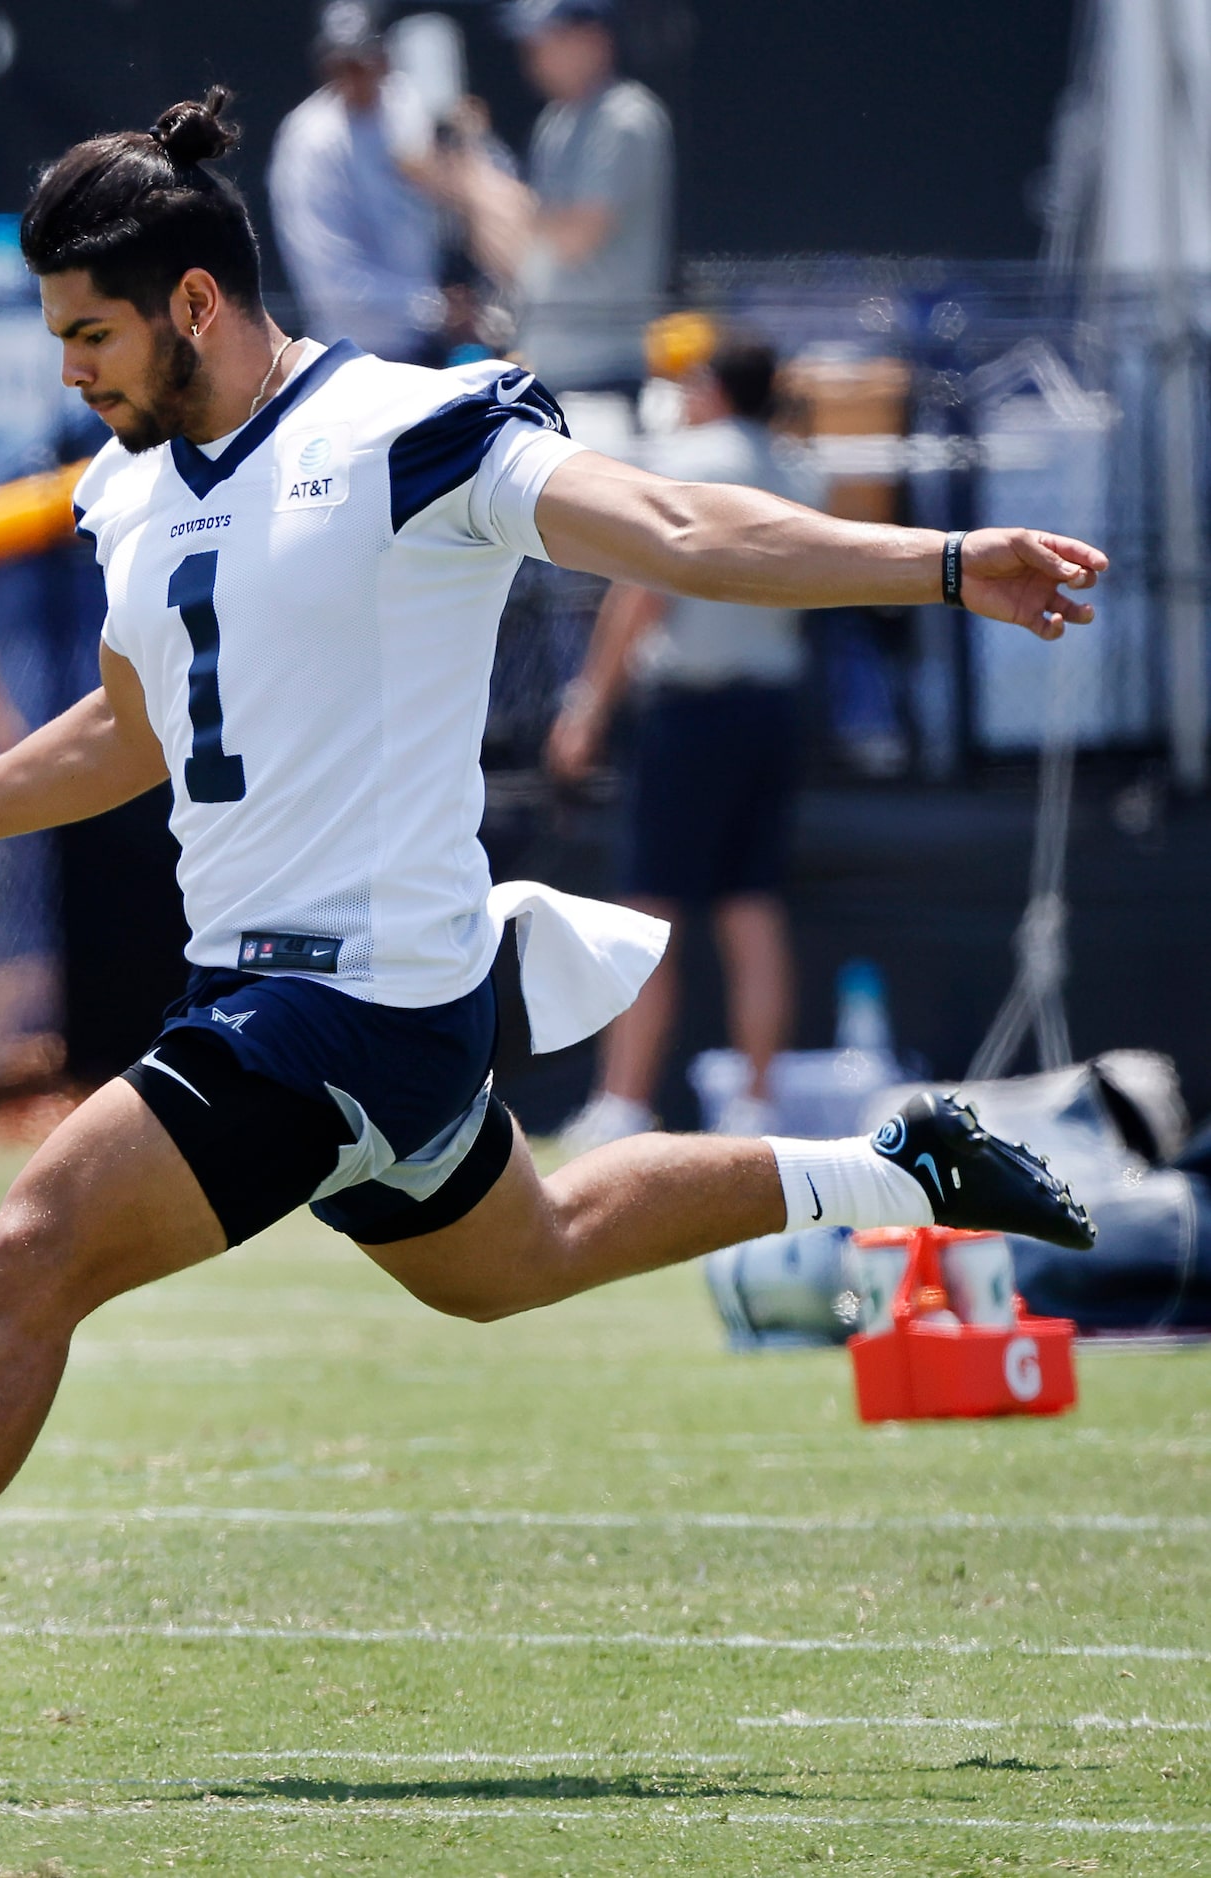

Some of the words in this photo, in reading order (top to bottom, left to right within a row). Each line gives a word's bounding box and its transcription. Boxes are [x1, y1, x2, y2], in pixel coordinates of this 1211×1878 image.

[288, 477, 333, 501] AT&T
[170, 514, 232, 538] COWBOYS
[167, 549, 246, 803] 1
[1003, 1337, 1043, 1402] G
